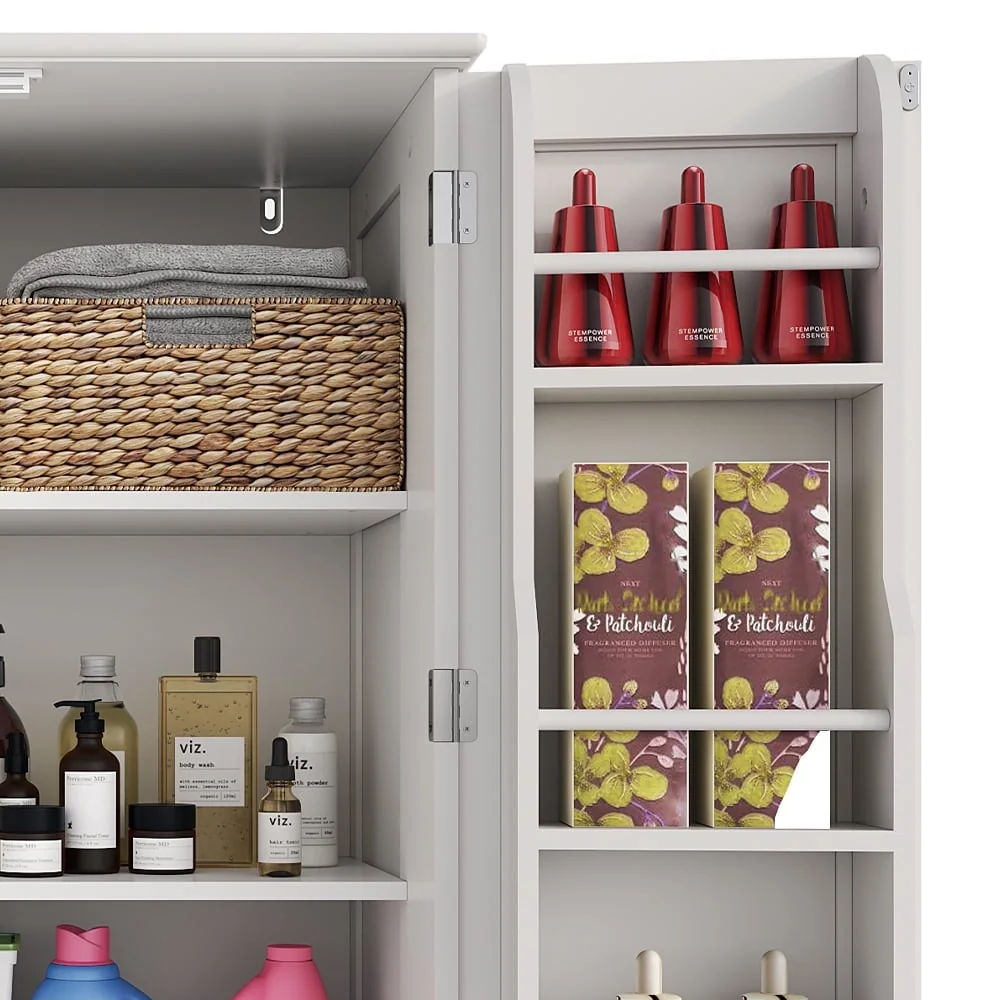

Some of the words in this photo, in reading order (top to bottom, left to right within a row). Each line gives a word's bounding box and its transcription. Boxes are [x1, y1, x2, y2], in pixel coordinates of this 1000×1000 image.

[568, 329, 612, 337] STEMPOWER
[678, 327, 723, 335] STEMPOWER
[684, 333, 718, 341] ESSENCE
[586, 614, 600, 632] &
[606, 613, 674, 633] Patchouli
[727, 614, 741, 632] &
[747, 612, 815, 633] Patchouli
[180, 740, 206, 753] viz.
[270, 815, 292, 826] viz.
